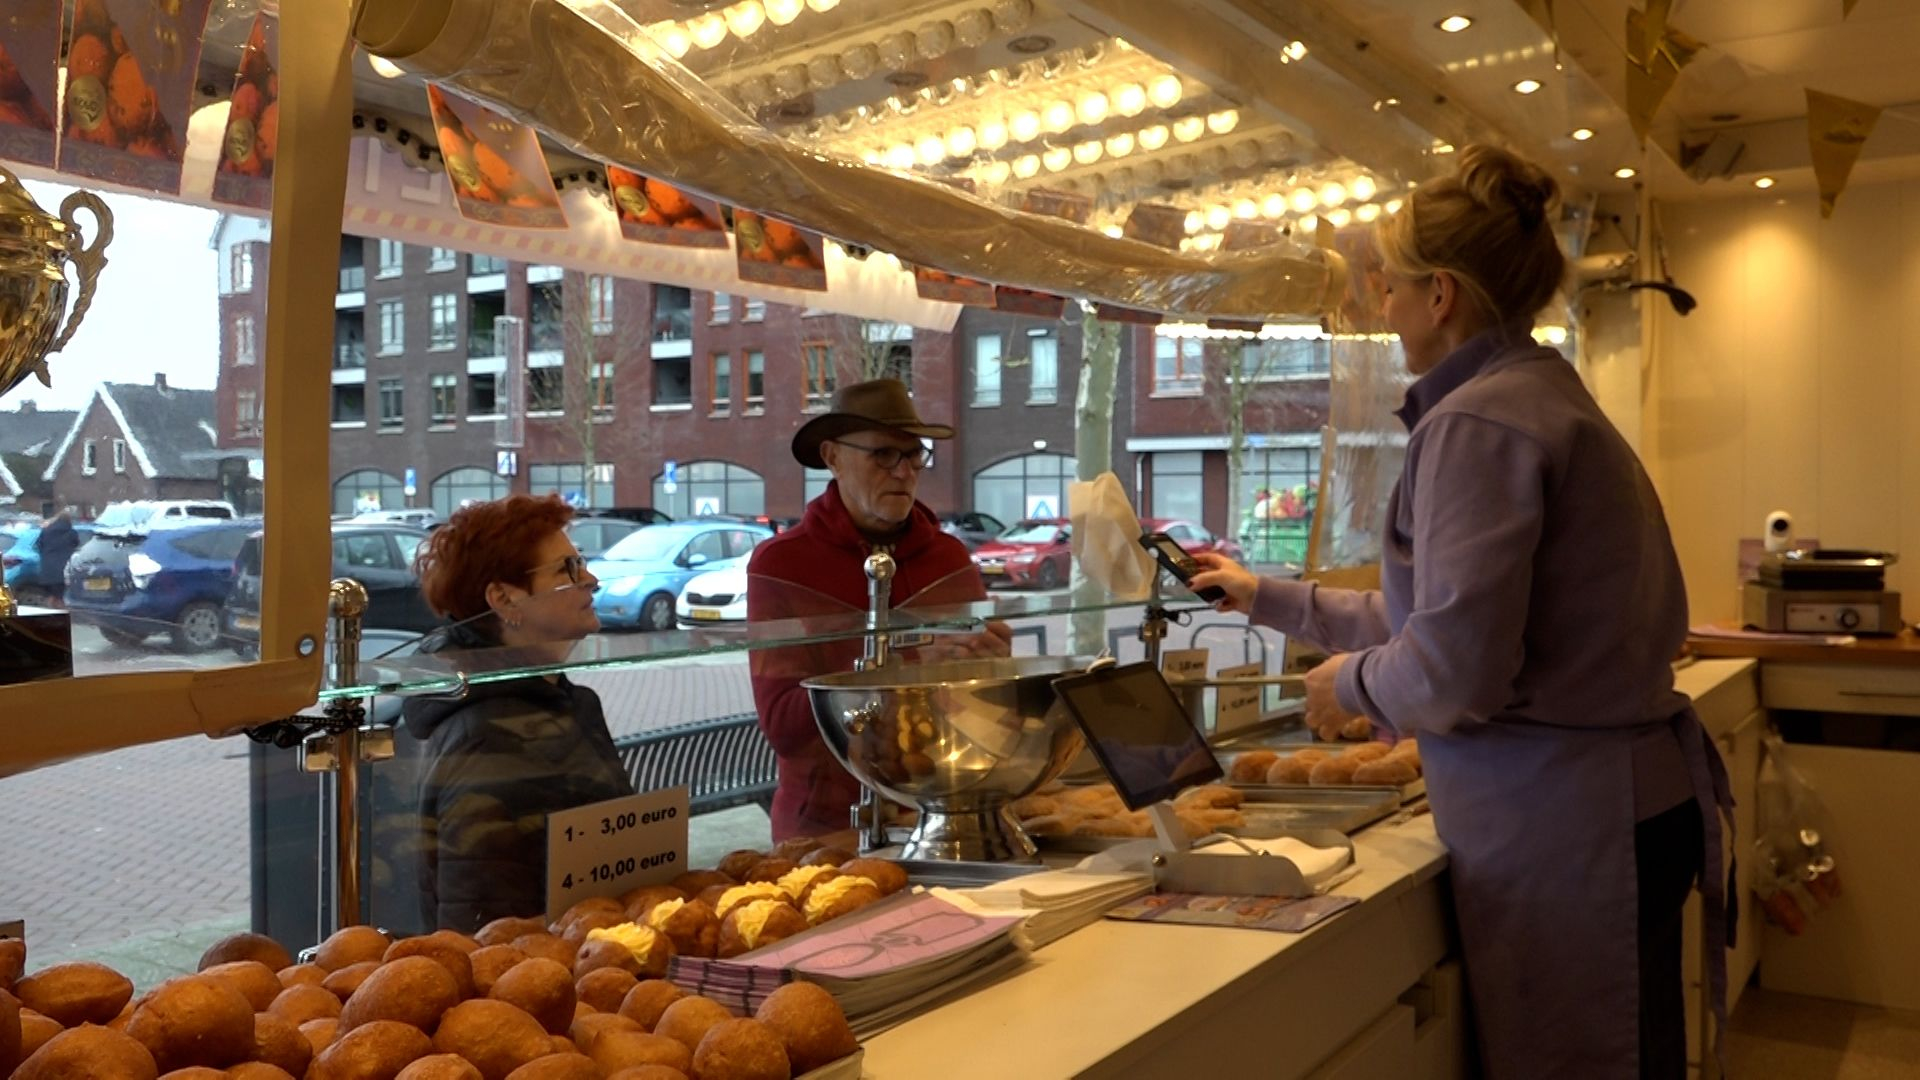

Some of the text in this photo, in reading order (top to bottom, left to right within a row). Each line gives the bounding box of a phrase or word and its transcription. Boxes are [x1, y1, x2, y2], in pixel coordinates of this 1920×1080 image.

[565, 826, 573, 841] 1
[601, 812, 636, 834] 3,00
[641, 806, 677, 824] euro
[562, 873, 573, 889] 4
[590, 857, 636, 882] 10,00
[640, 850, 676, 870] euro
